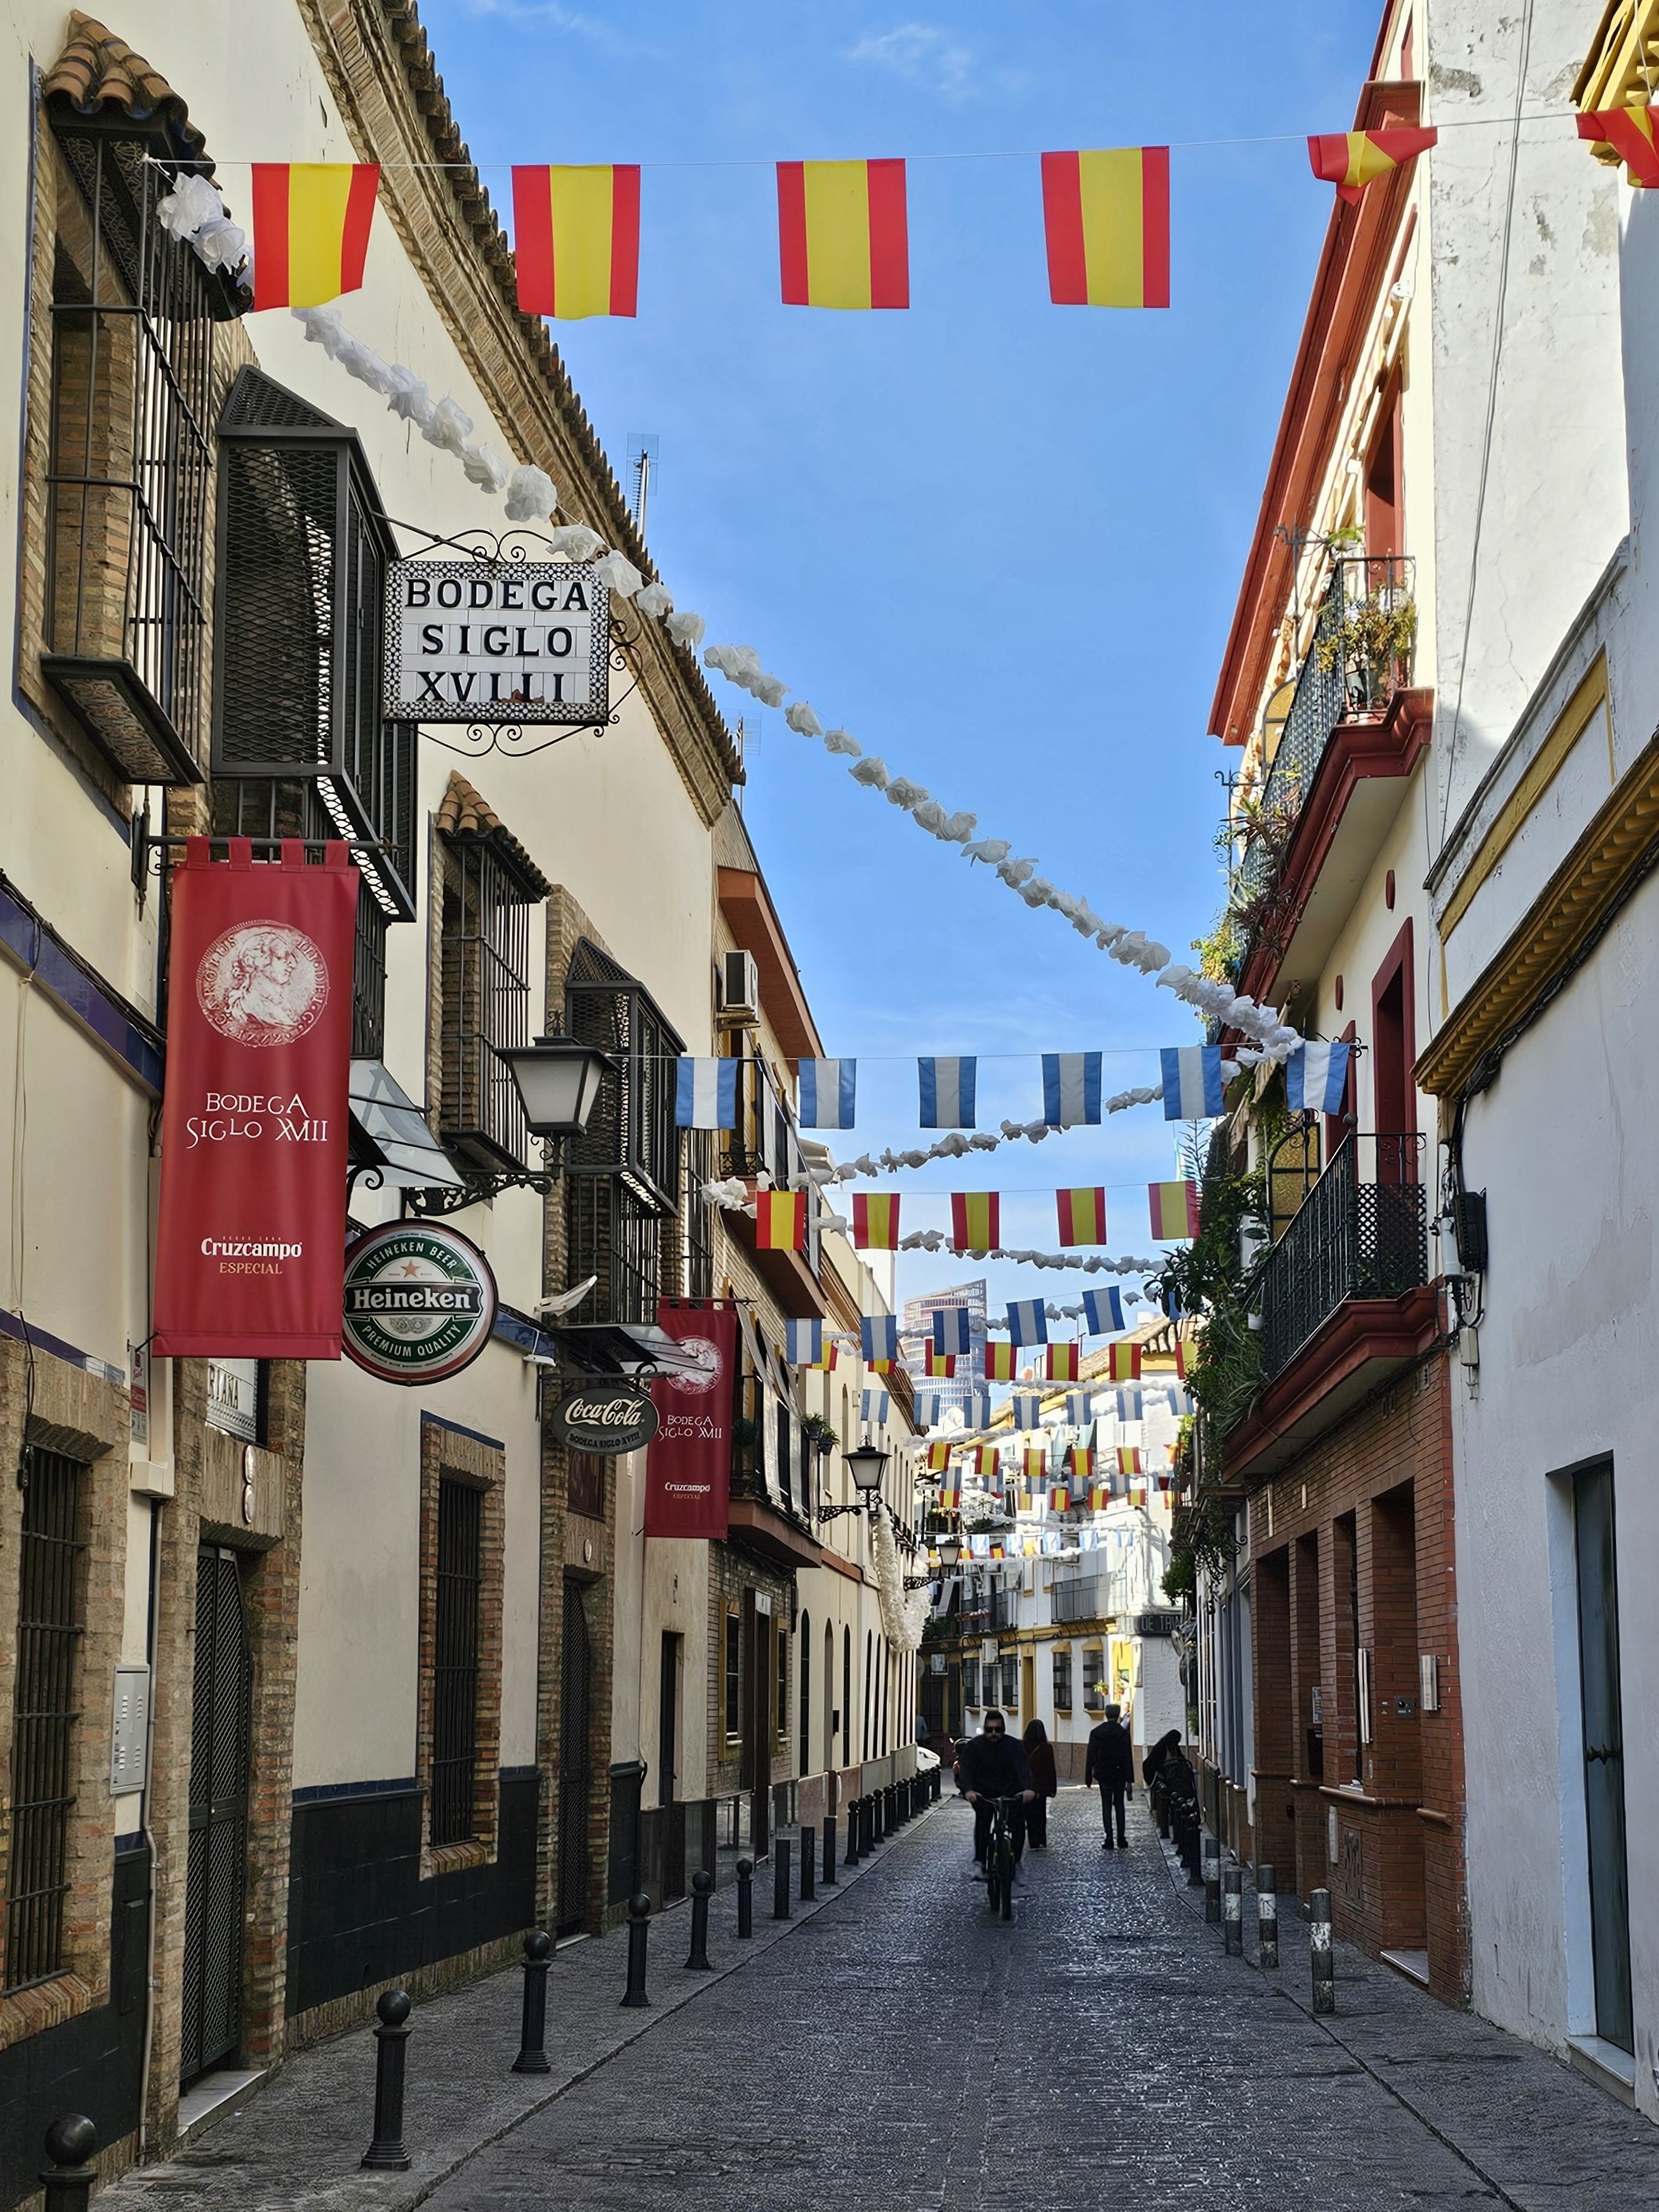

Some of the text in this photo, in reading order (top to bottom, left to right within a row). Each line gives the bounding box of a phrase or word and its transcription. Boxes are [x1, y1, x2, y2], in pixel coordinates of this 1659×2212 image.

[405, 578, 589, 610] BODEGA
[422, 624, 573, 657] SIGLO
[417, 671, 565, 702] XVIII
[205, 1092, 310, 1118] BODEGA
[185, 1117, 263, 1149] SIGLO
[201, 1237, 303, 1260] Cruzcampo
[366, 1242, 458, 1269] HEINEKEN BEER
[220, 1262, 282, 1274] ESPECIAL
[353, 1287, 471, 1309] Heineken
[362, 1324, 461, 1357] PREMIUM QUALITY
[564, 1398, 645, 1426] Coca-Cola
[667, 1414, 714, 1427] BODEGA
[569, 1433, 598, 1448] BODEGA
[658, 1425, 693, 1442] SIGLO
[665, 1481, 711, 1493] Cruzcampo
